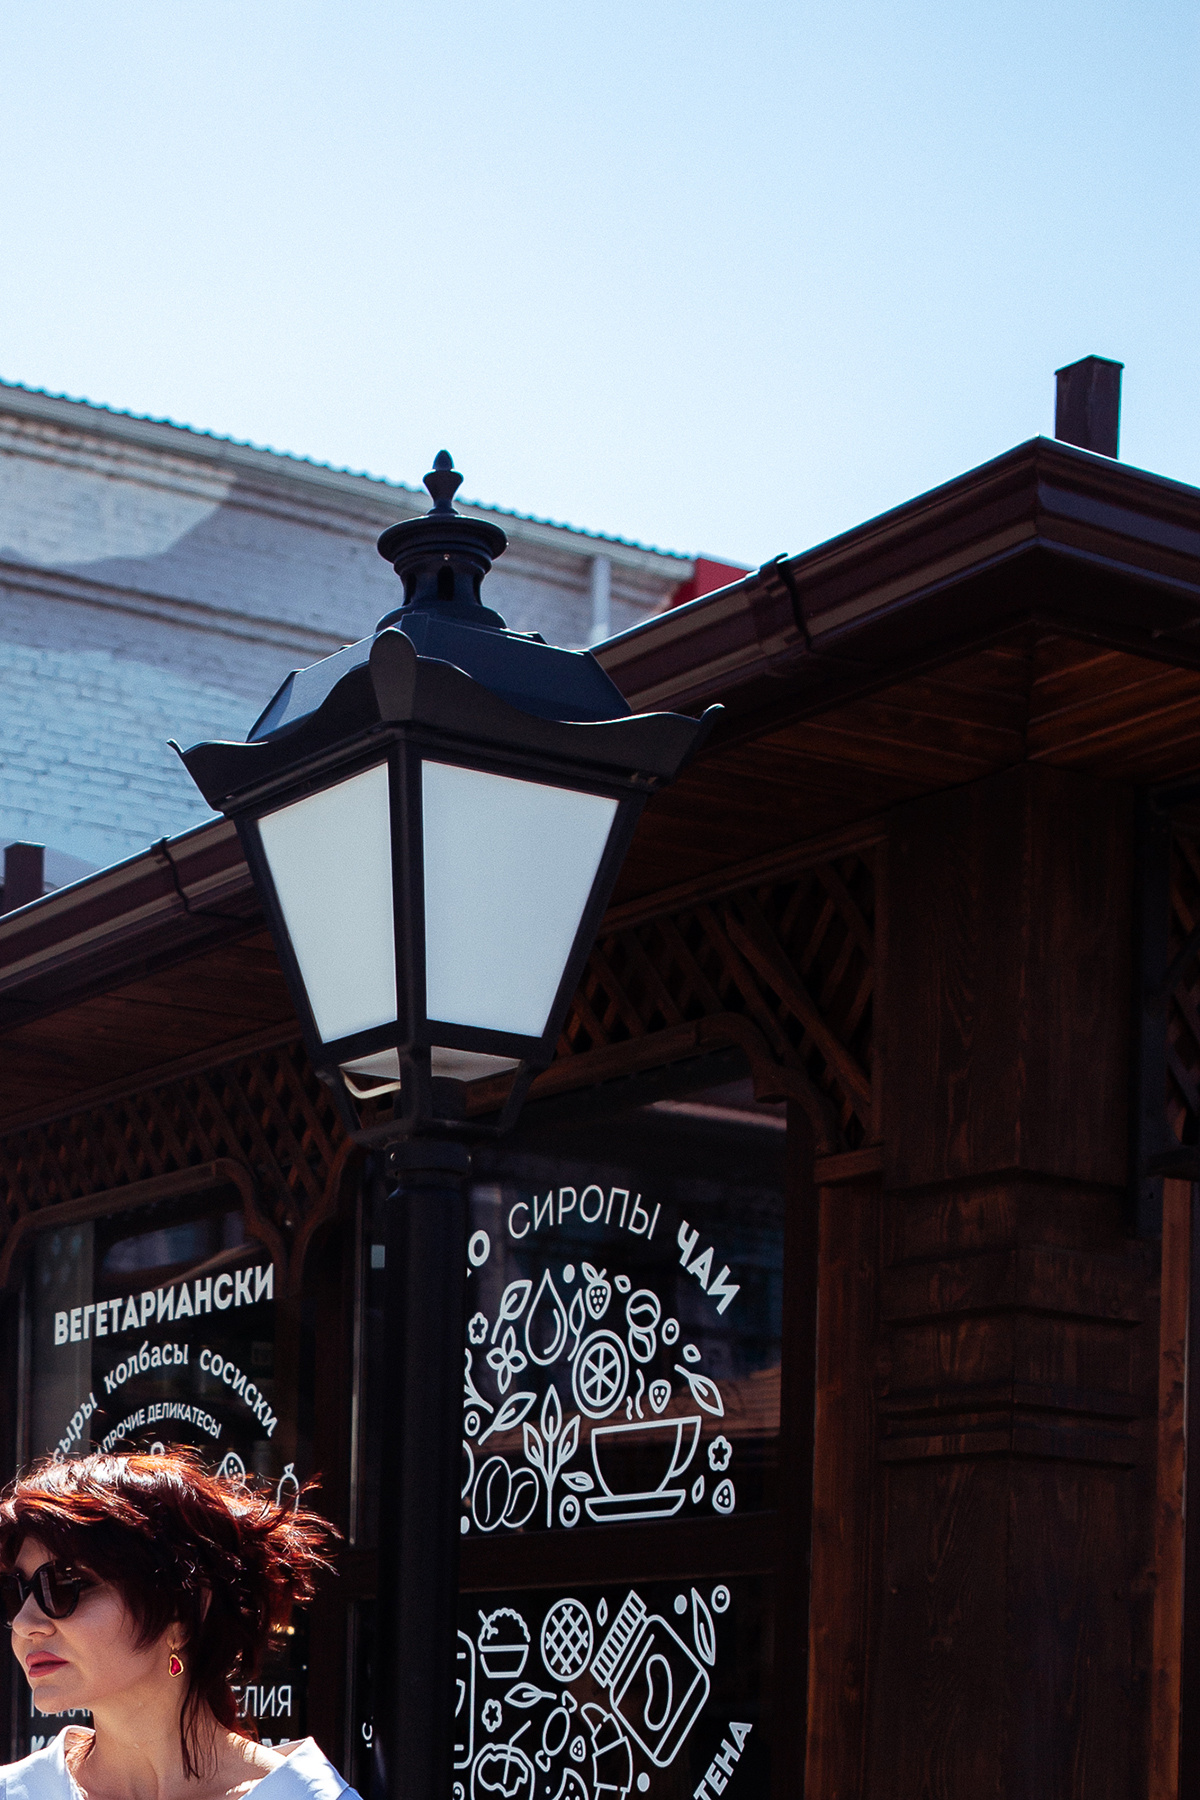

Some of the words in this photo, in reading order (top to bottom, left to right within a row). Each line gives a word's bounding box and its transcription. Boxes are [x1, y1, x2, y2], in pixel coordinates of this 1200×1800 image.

[508, 1184, 661, 1240] СИРОПЫ
[676, 1219, 741, 1316] ЧАИ
[54, 1263, 274, 1346] ВЕГЕТАРИАНСКИ
[102, 1405, 146, 1450] ПРОЧИЕ
[147, 1402, 223, 1439] ДЕЛИКАТЕСЫ
[103, 1340, 189, 1395] колбасы
[199, 1348, 278, 1438] сосиски
